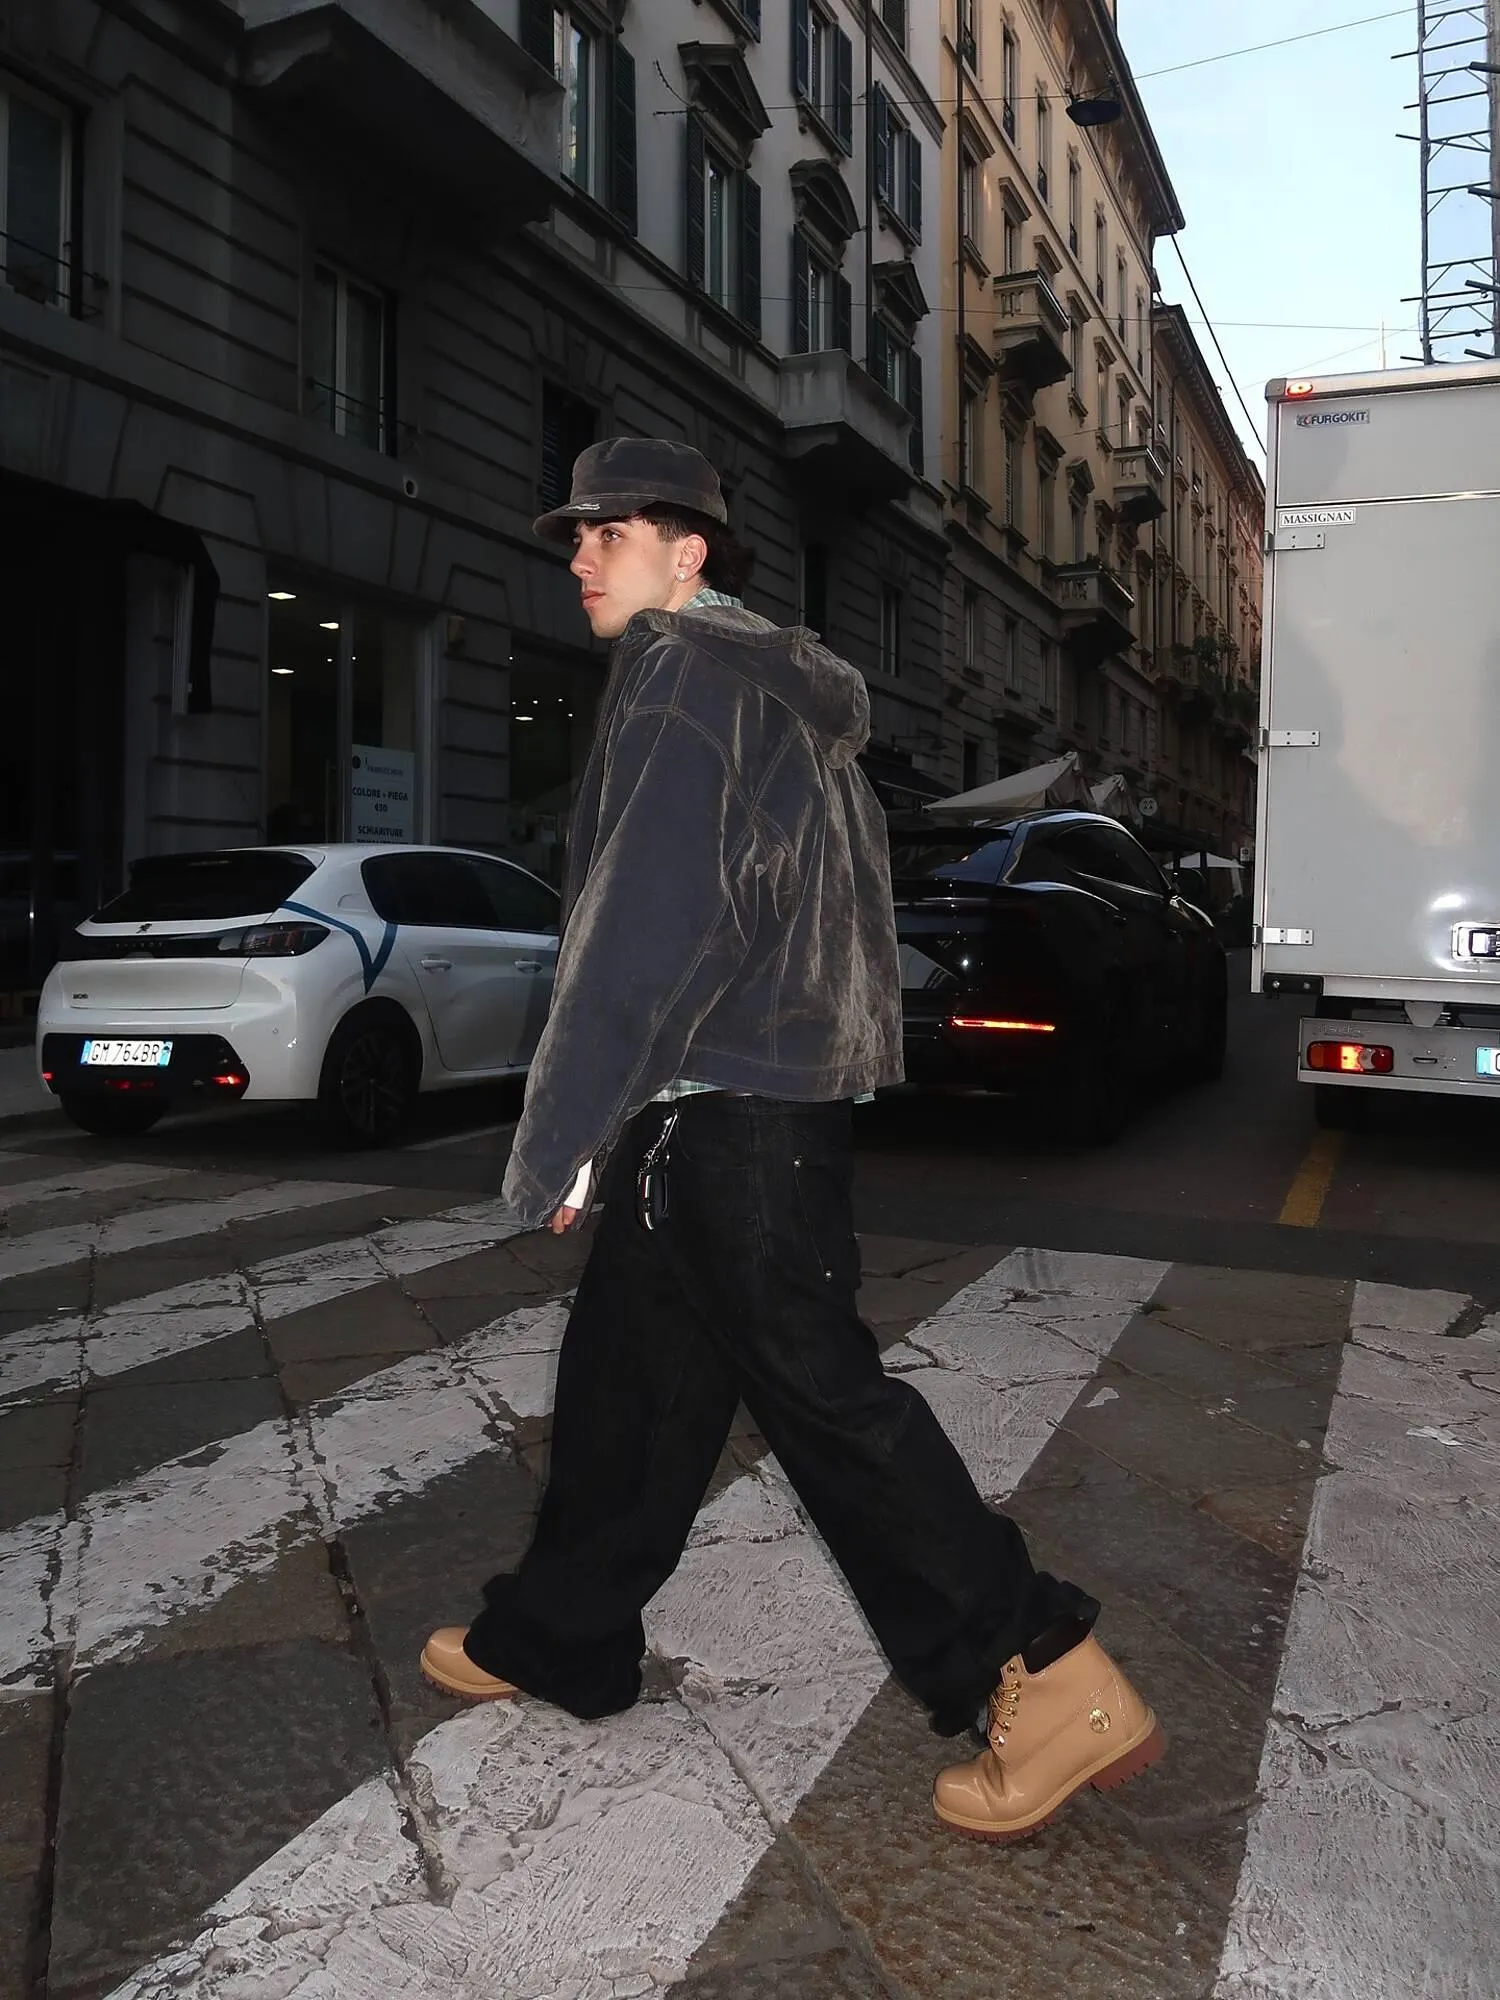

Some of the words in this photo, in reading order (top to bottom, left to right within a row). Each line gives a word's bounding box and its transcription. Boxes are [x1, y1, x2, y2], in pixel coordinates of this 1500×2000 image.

[1311, 412, 1367, 424] FURGOKIT
[1283, 511, 1352, 524] MASSIGNAN
[352, 787, 381, 798] COLORE
[387, 791, 408, 800] PIEGA
